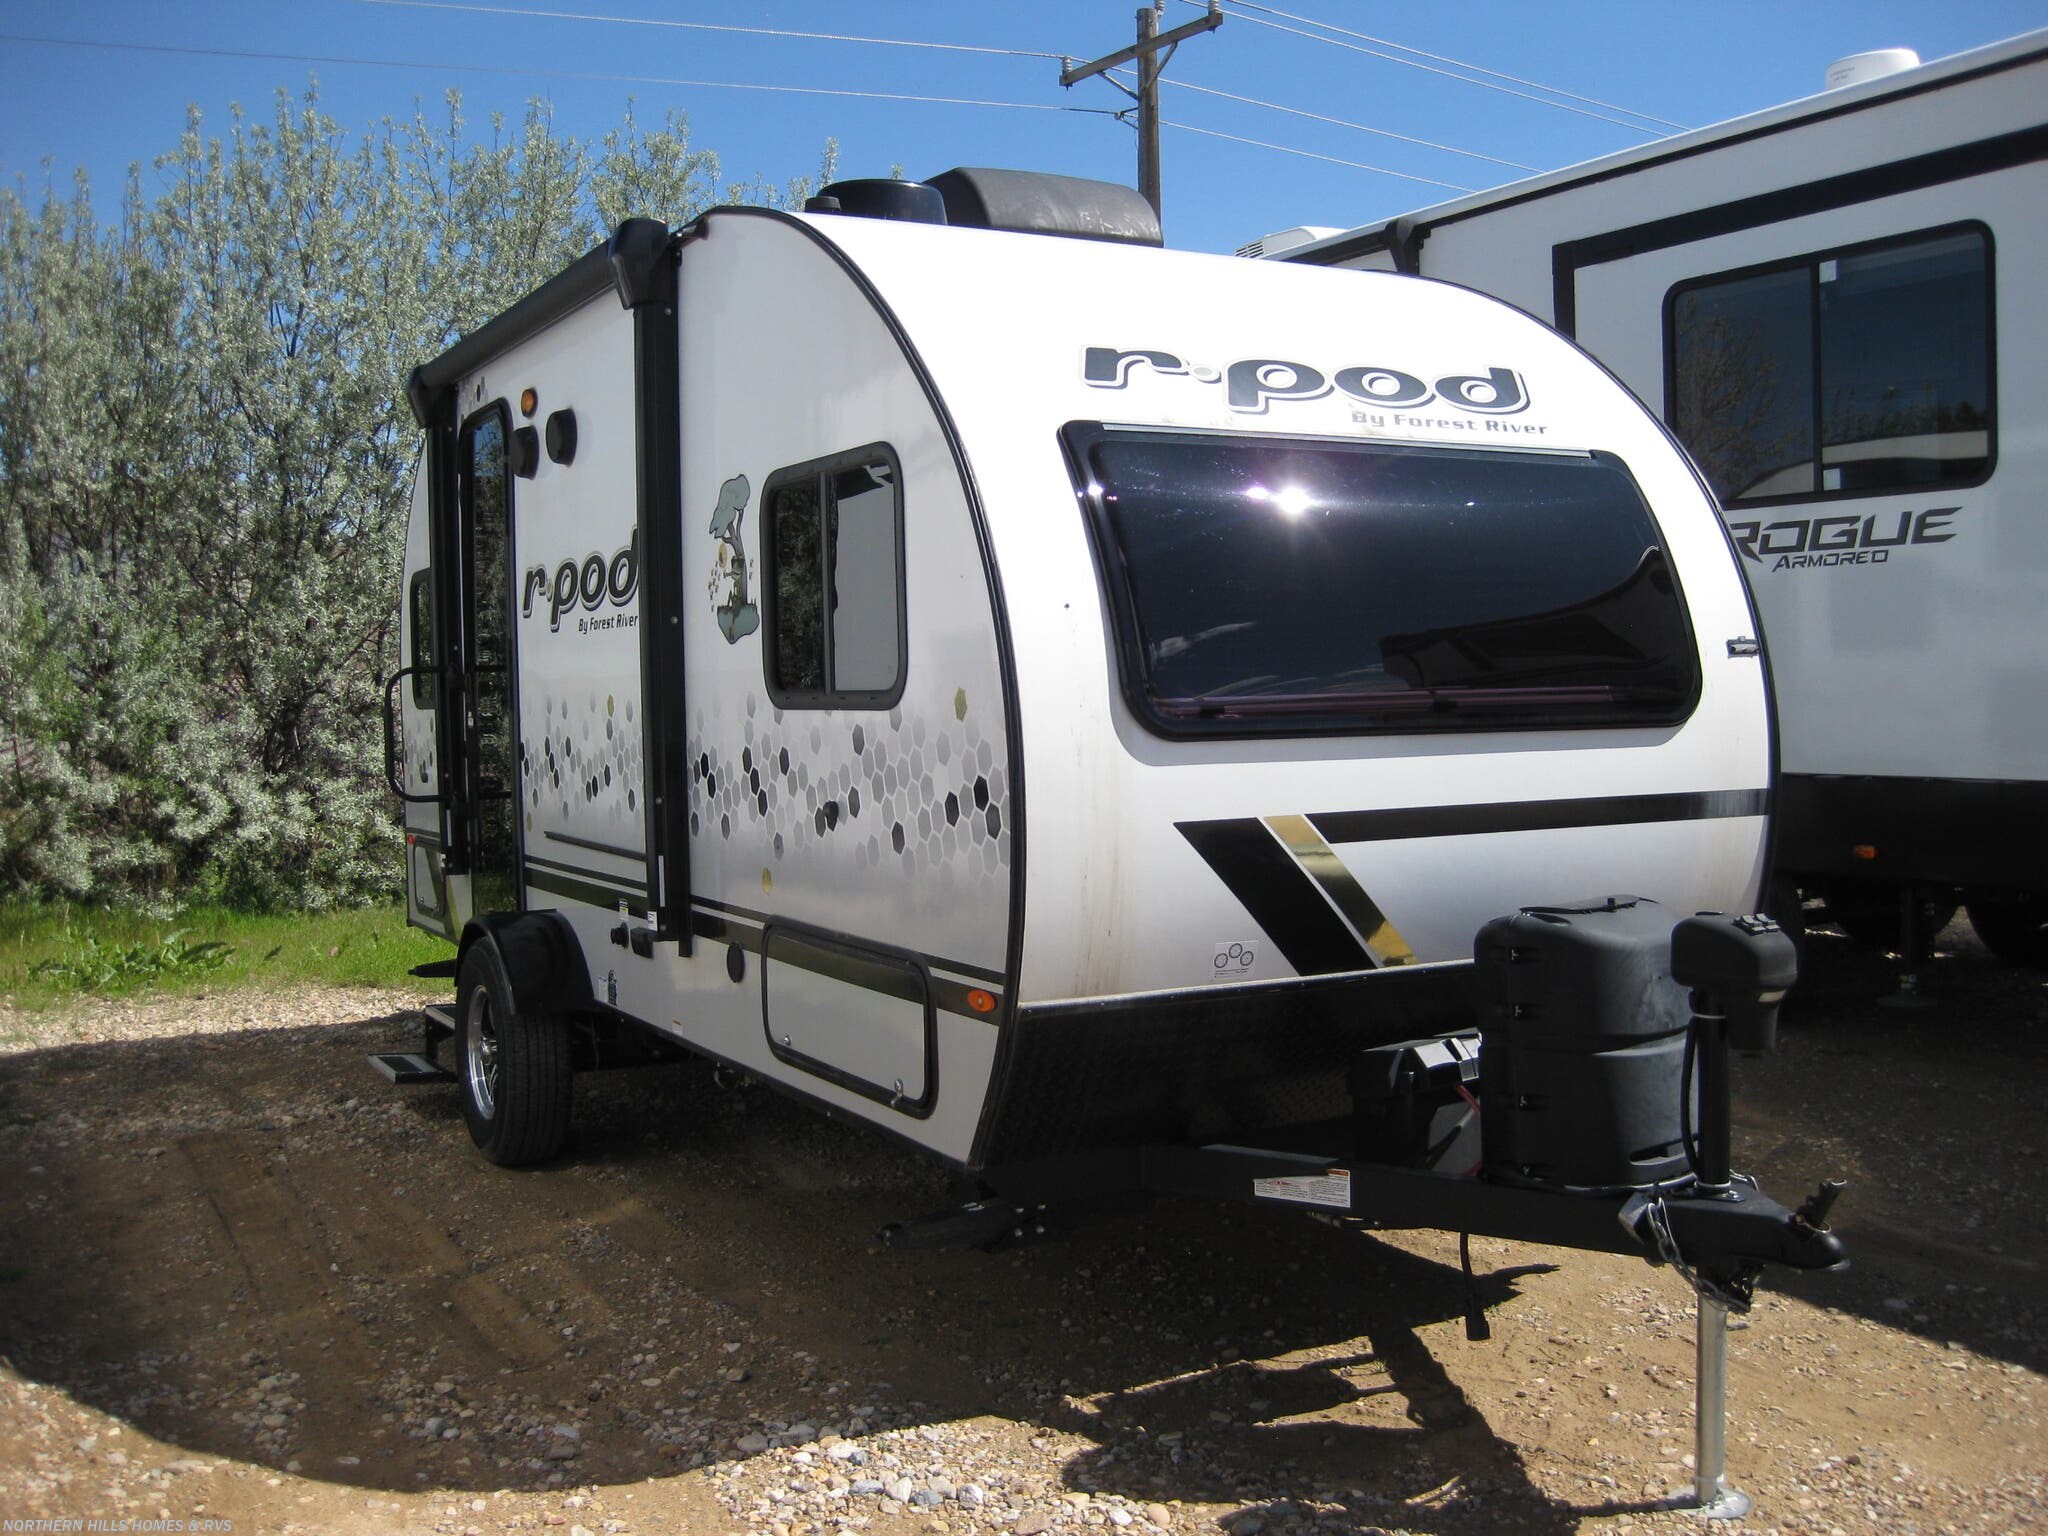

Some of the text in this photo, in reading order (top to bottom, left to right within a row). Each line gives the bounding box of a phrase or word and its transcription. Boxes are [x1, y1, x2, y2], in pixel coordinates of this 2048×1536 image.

[1352, 411, 1547, 435] By Forest River
[1729, 507, 1963, 563] ROGUE
[1772, 550, 1889, 573] ARMORED
[578, 613, 638, 634] By Forest River
